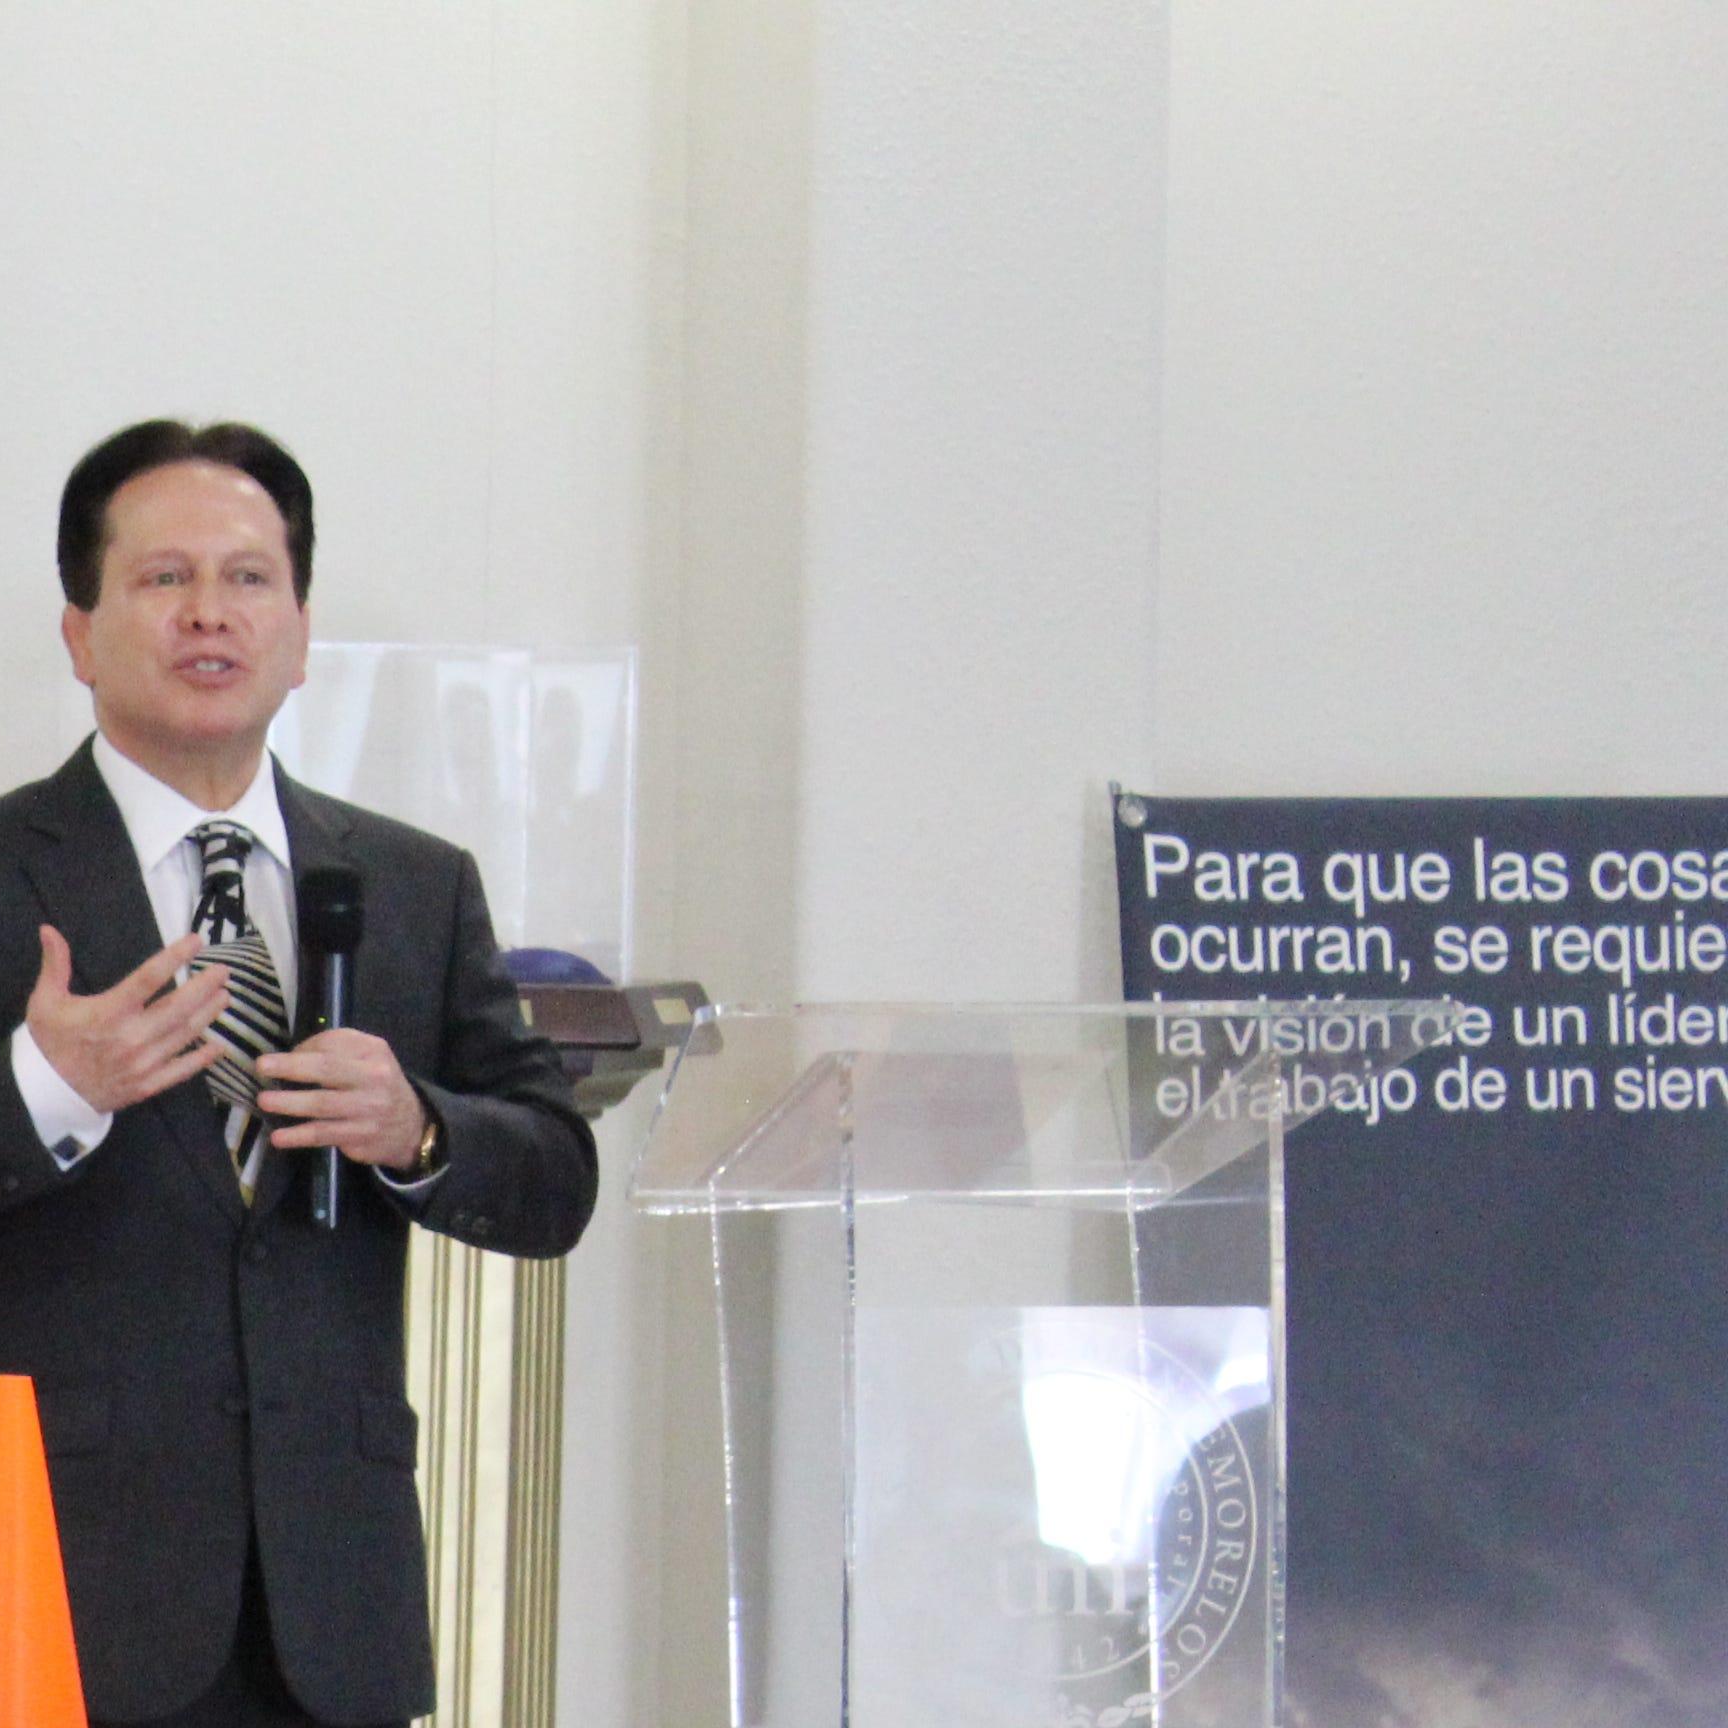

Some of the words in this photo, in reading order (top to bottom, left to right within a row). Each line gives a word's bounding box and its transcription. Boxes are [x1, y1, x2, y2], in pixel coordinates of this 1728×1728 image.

[1144, 834, 1303, 902] Para
[1324, 851, 1450, 918] que
[1475, 838, 1568, 902] las
[1150, 923, 1411, 983] ocurran,
[1434, 925, 1507, 973] se
[1153, 992, 1205, 1056] la
[1222, 994, 1391, 1056] visión
[1410, 994, 1491, 1047] de
[1513, 1005, 1585, 1045] un
[1156, 1066, 1201, 1119] el
[1212, 1058, 1417, 1126] trabajo
[1435, 1057, 1506, 1112] de
[1528, 1066, 1593, 1112] un
